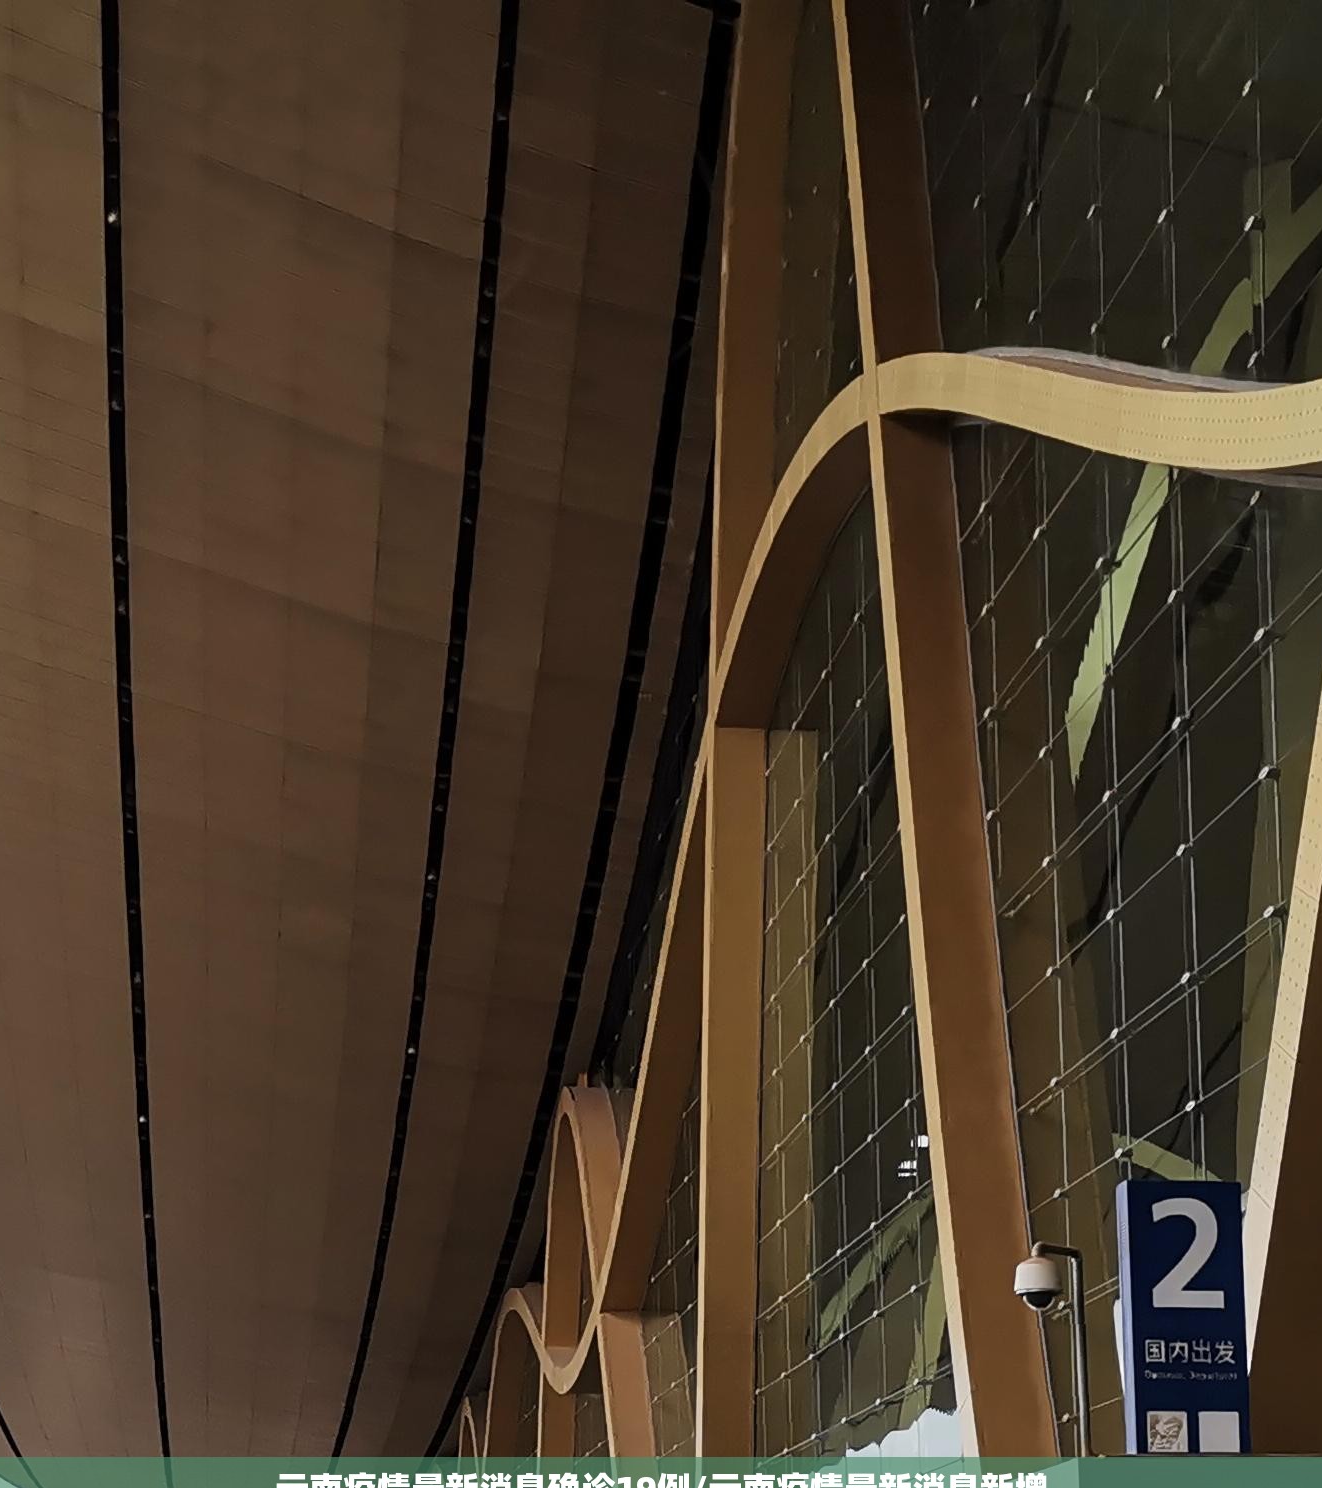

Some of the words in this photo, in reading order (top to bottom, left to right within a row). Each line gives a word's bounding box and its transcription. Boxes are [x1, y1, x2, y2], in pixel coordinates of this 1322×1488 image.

[1151, 1197, 1225, 1309] 2
[1144, 1338, 1237, 1365] 国内出发
